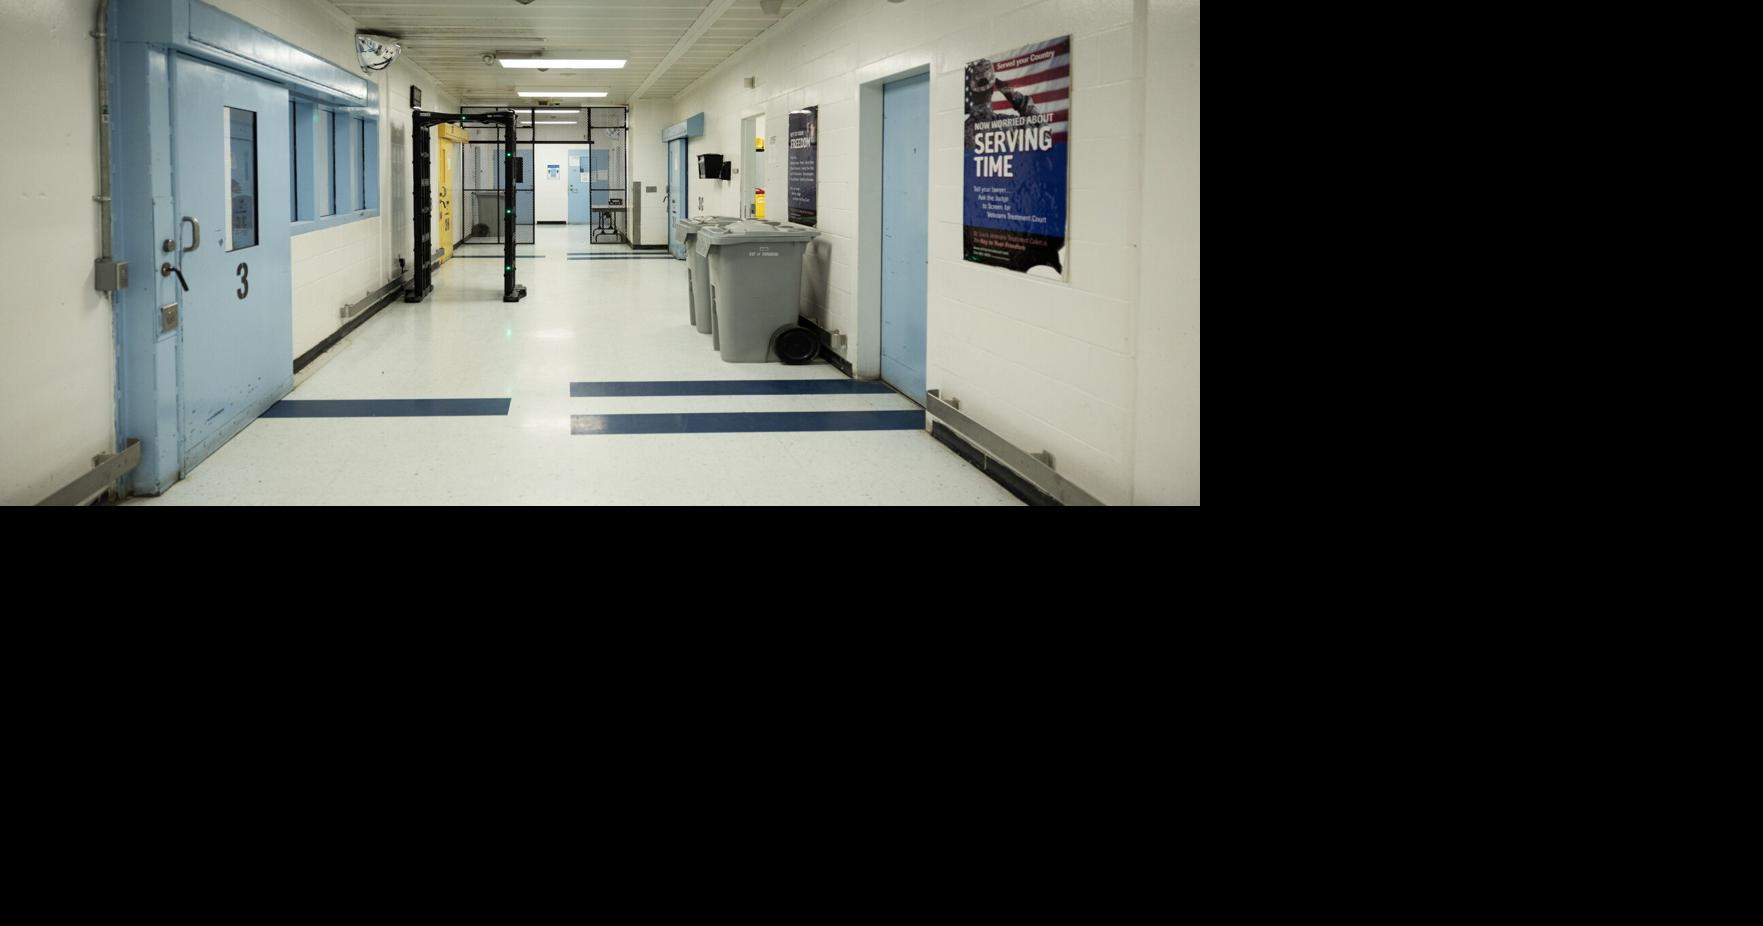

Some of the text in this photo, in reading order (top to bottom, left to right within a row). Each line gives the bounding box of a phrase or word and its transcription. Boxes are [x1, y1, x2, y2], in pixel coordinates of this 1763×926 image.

[996, 51, 1055, 70] Served your Country
[974, 113, 1055, 131] NOW WORRIED ABOUT
[790, 137, 811, 149] FREEDOM
[974, 126, 1053, 154] SERVING
[973, 155, 1014, 178] TIME
[1032, 215, 1047, 223] Court
[236, 262, 249, 300] 3
